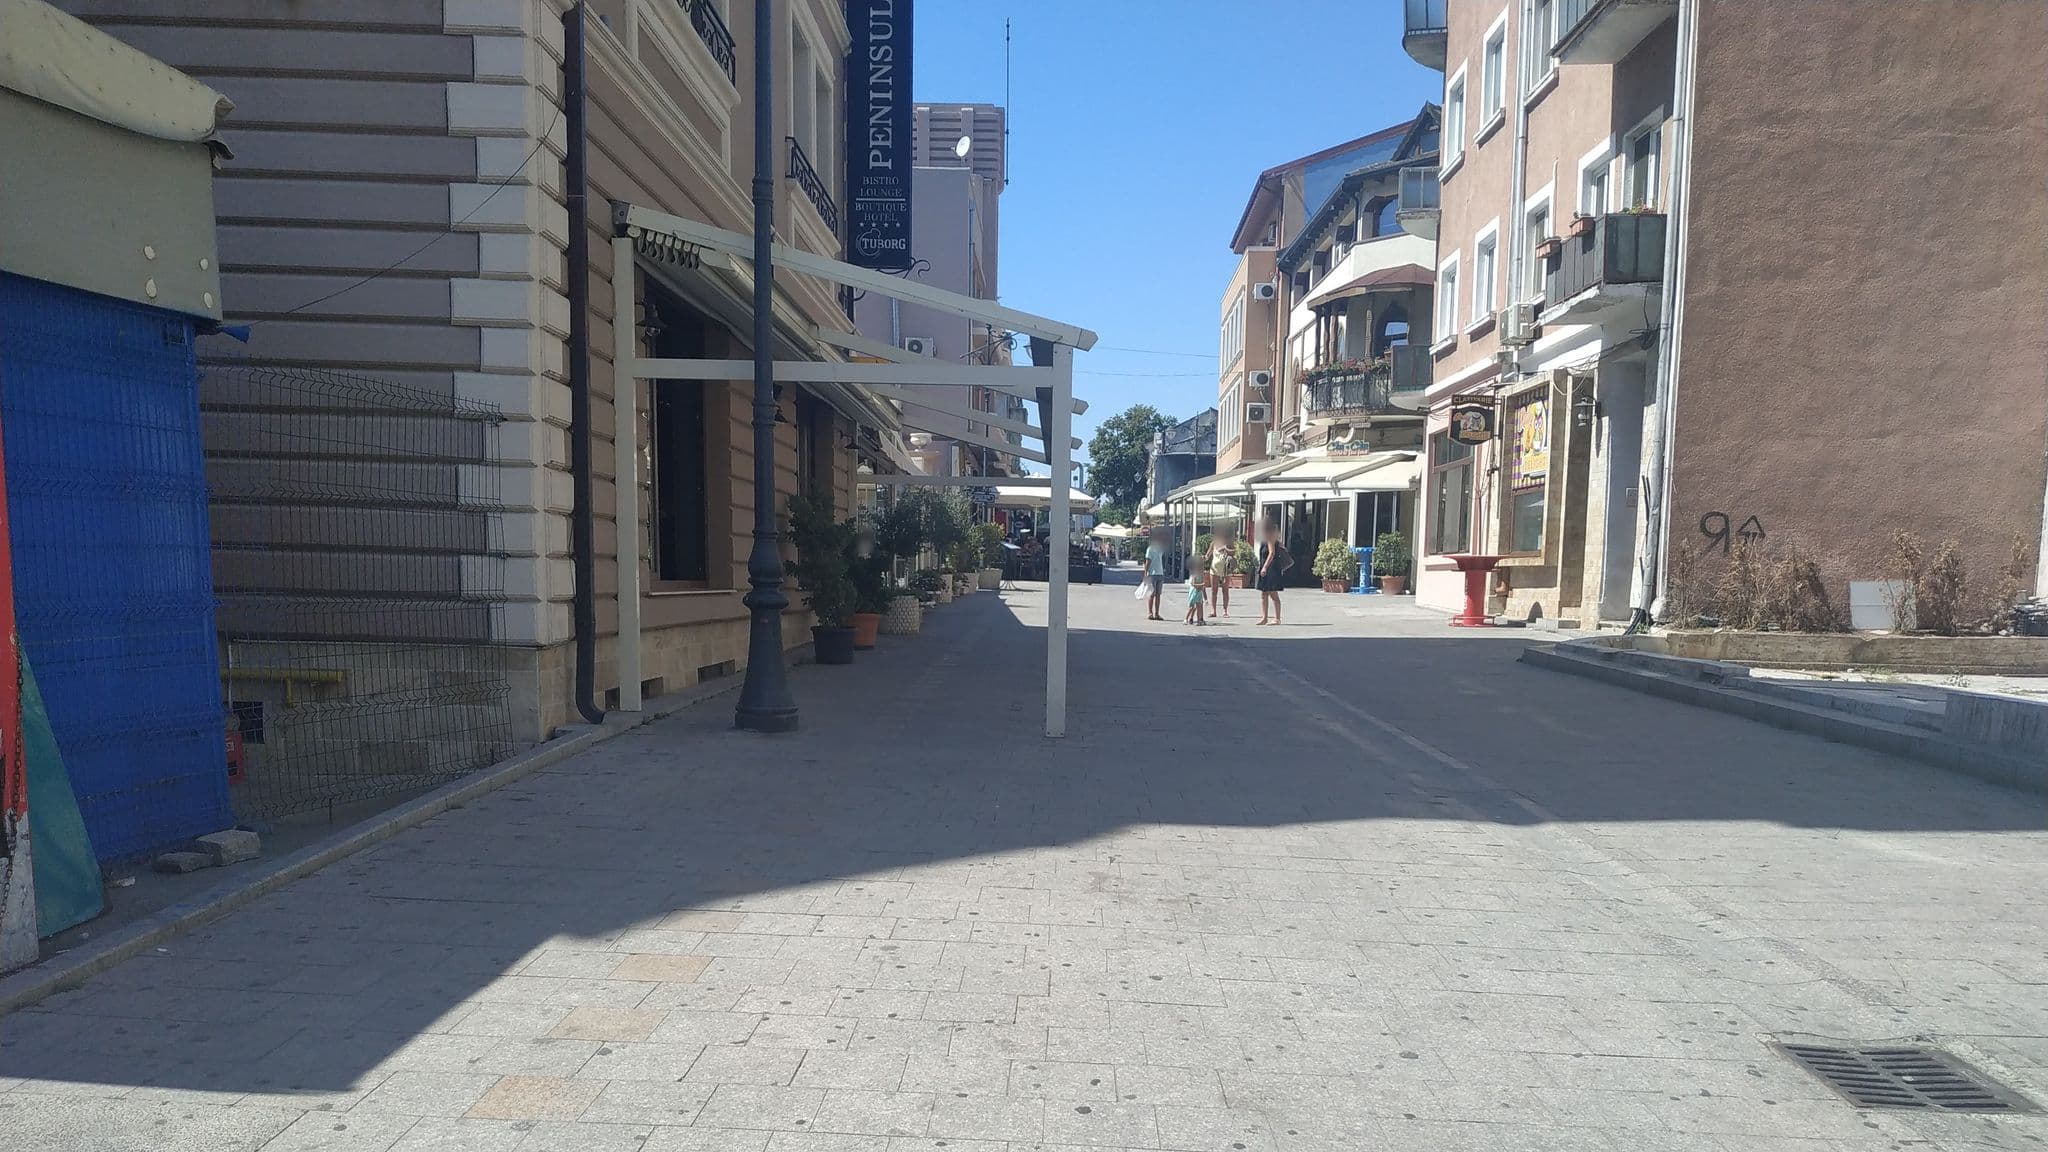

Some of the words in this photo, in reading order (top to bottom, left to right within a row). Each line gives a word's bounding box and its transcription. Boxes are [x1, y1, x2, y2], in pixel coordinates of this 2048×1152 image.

[869, 0, 893, 170] PENINSUL
[862, 176, 899, 185] BISTRO
[860, 188, 903, 197] LOUNGE
[855, 202, 907, 212] BOUTIQUE
[864, 213, 898, 221] HOTEL
[862, 238, 906, 250] TUBORG
